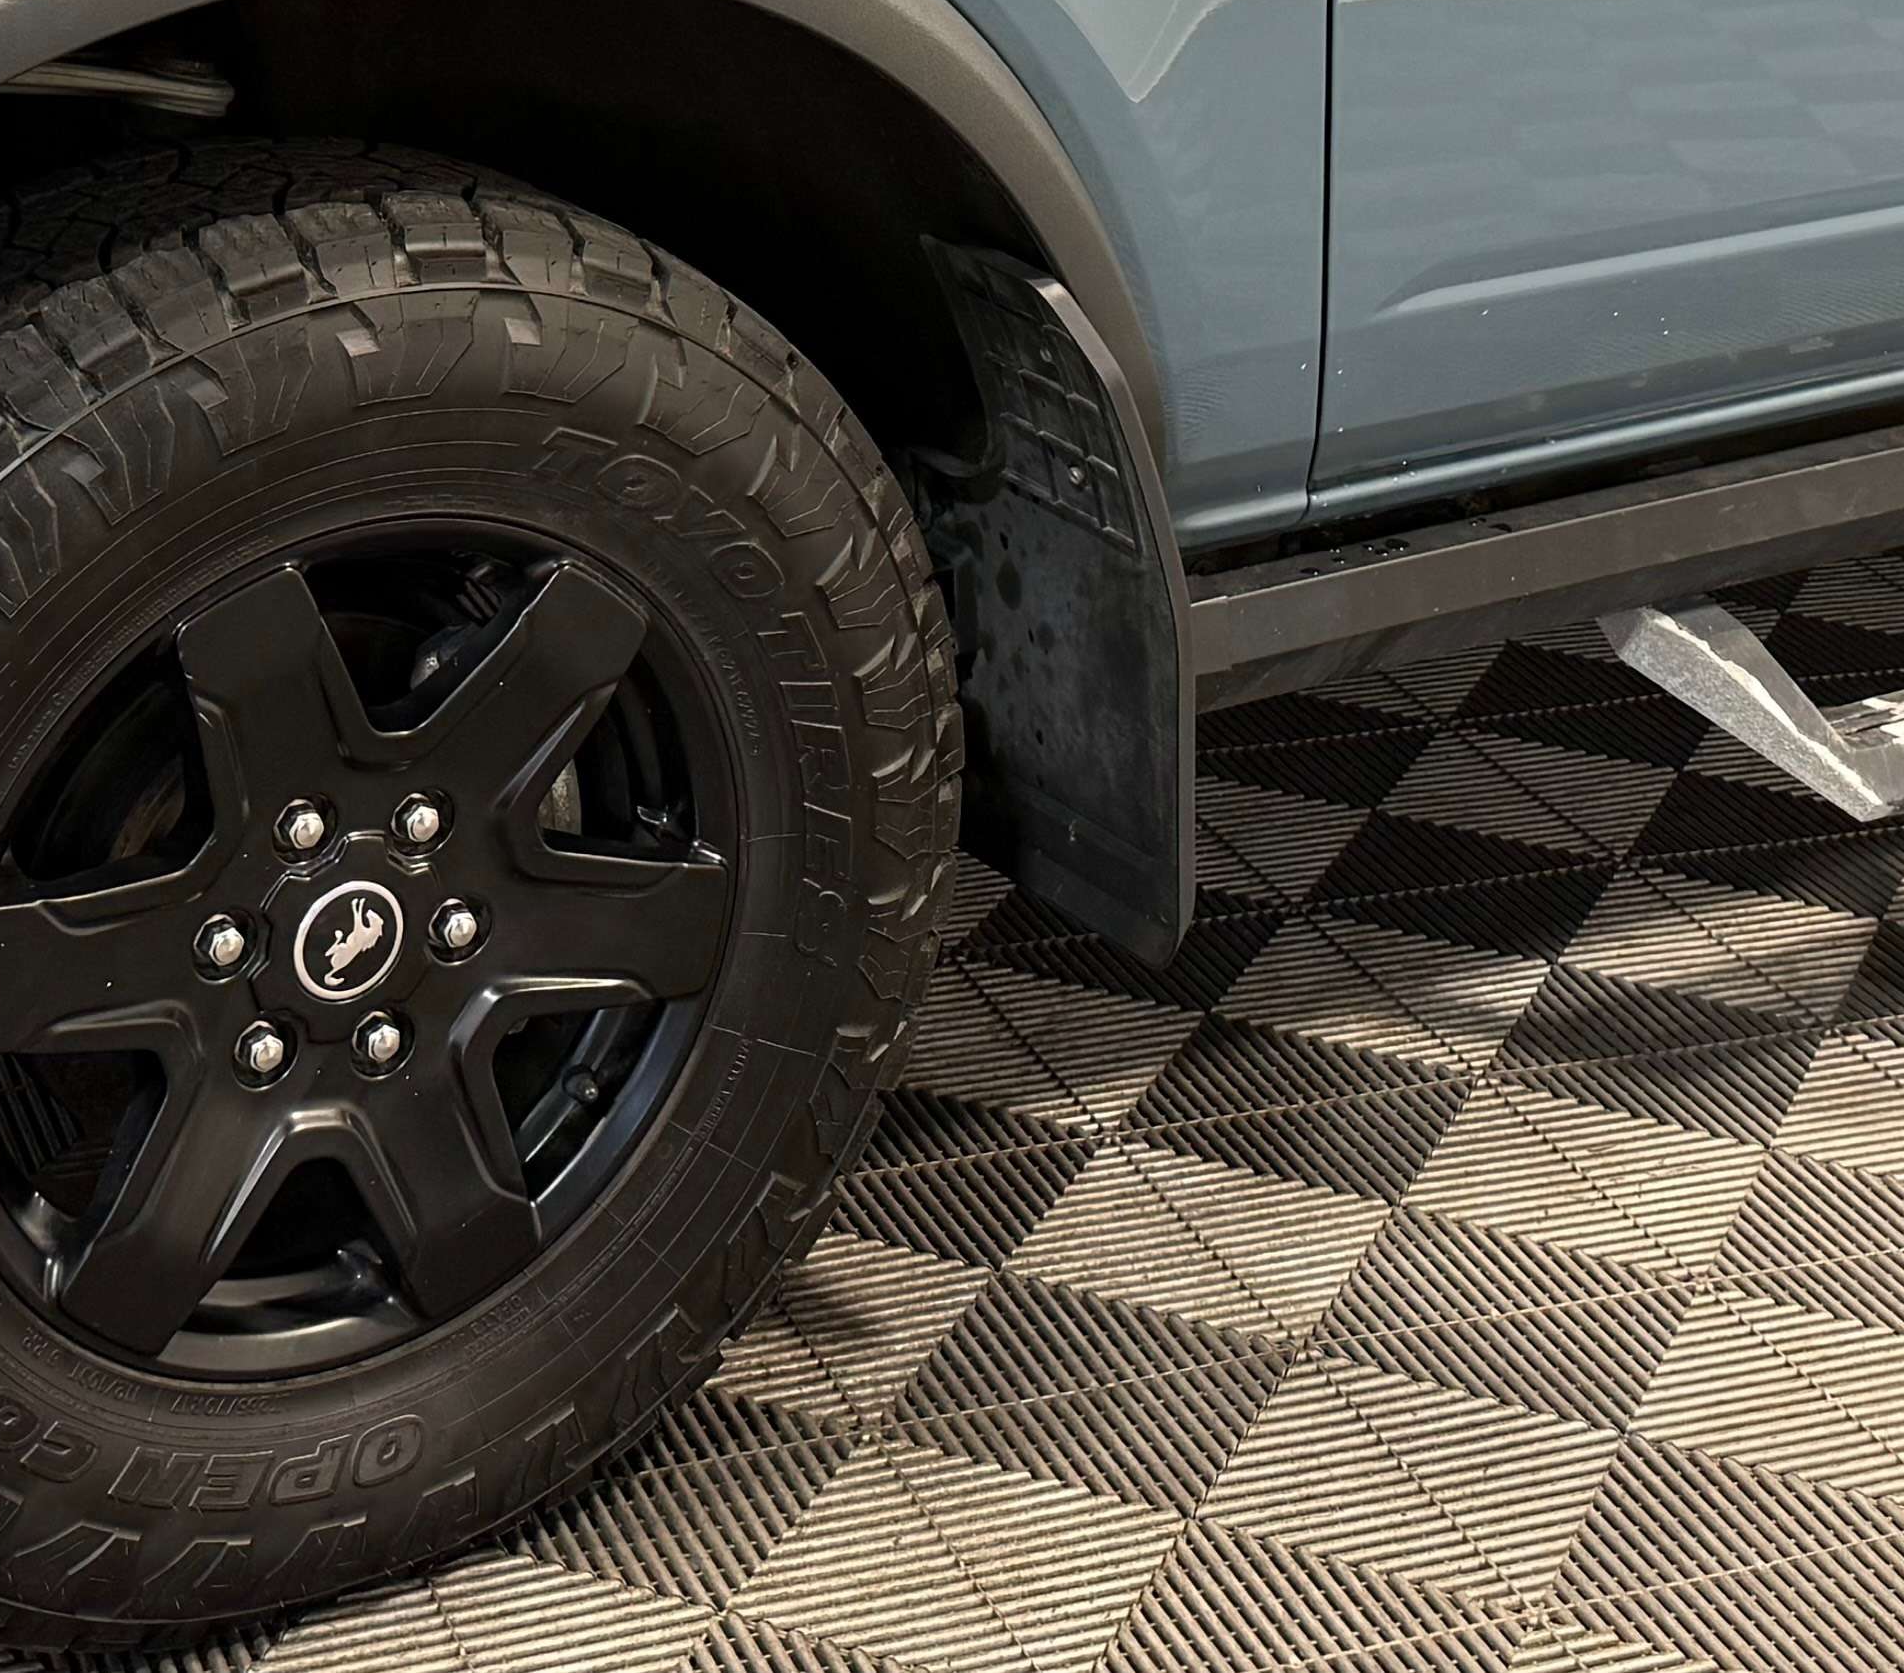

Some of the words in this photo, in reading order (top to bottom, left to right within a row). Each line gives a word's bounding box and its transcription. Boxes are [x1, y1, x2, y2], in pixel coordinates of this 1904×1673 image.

[531, 426, 785, 599] TOYO
[756, 610, 854, 970] TIRES
[106, 1413, 425, 1513] OPEN
